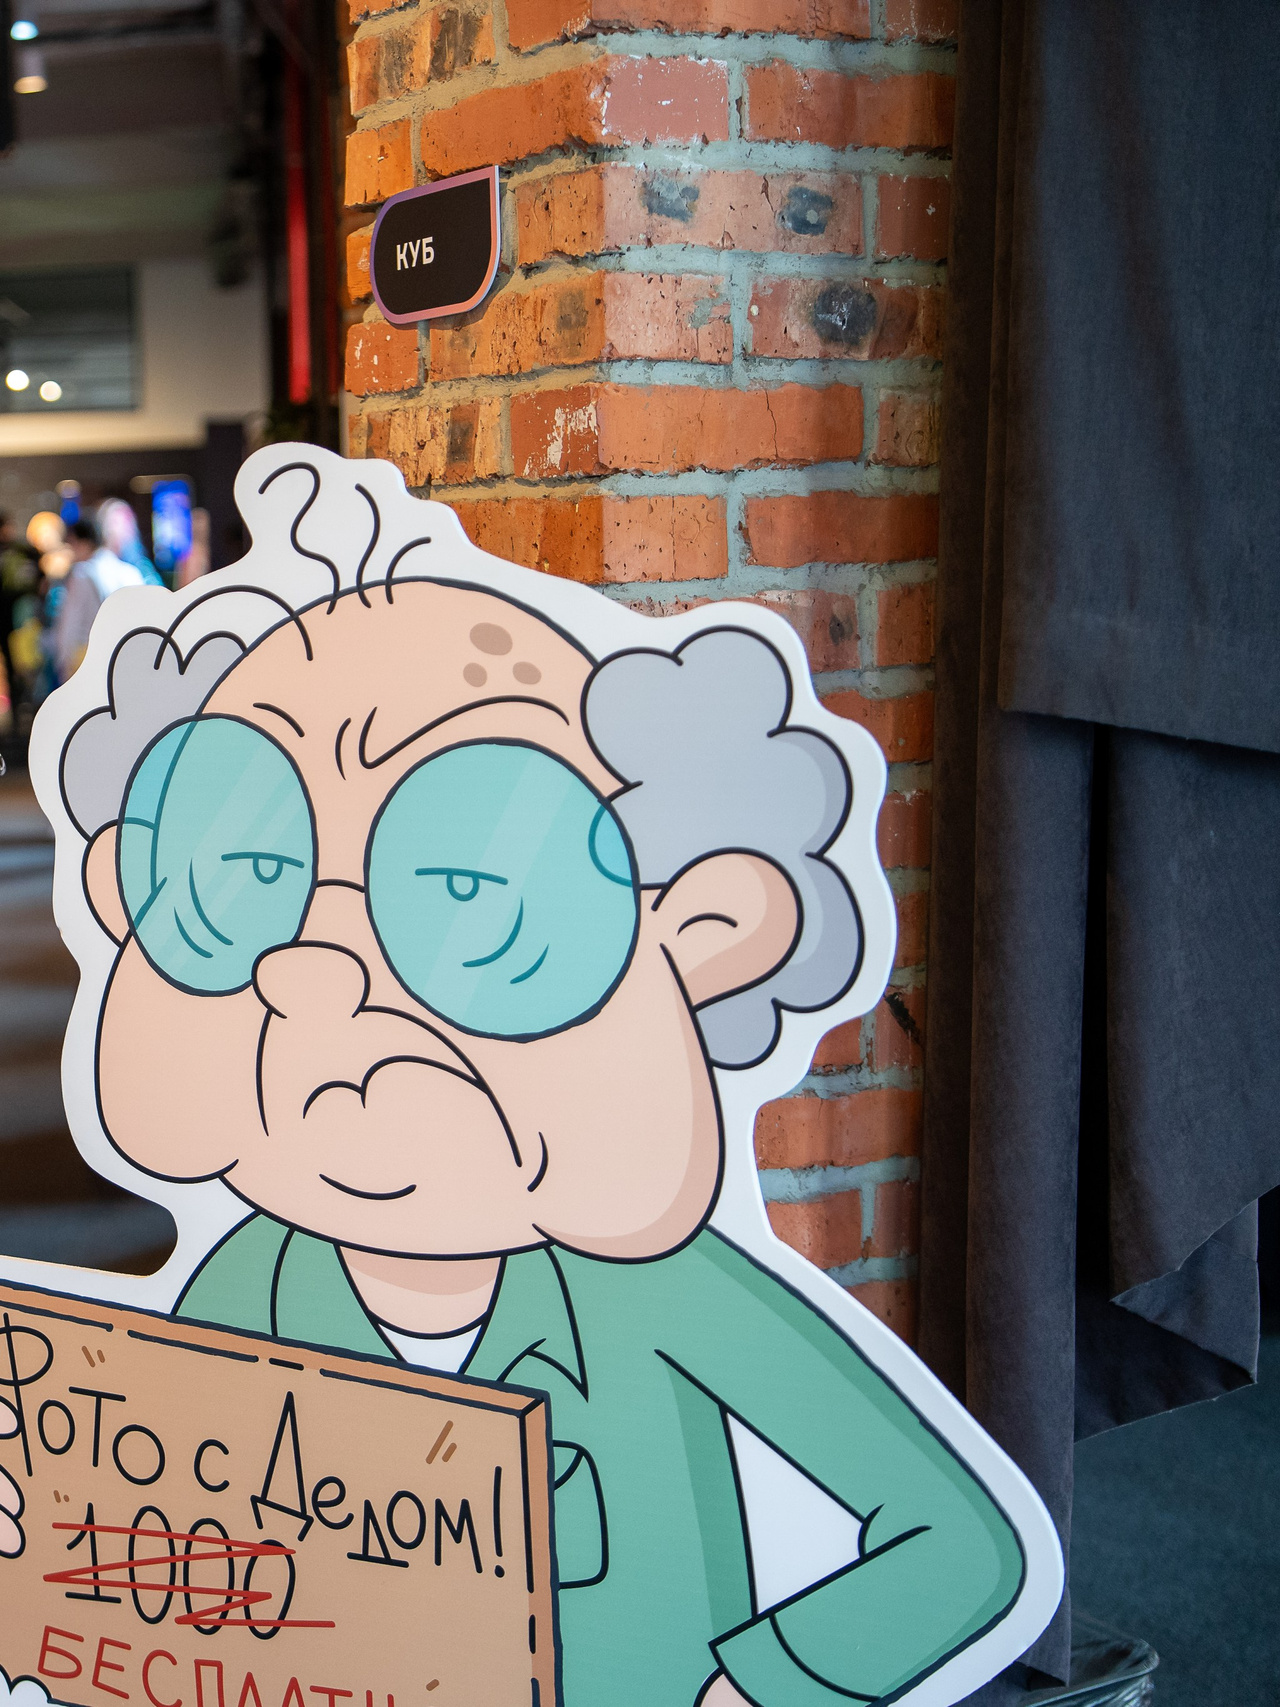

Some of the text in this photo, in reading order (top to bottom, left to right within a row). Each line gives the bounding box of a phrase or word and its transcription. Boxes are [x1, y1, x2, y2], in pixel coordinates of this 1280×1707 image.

[396, 236, 435, 271] КУБ
[193, 1437, 231, 1493] с
[249, 1390, 507, 1578] Дедом!
[65, 1502, 297, 1640] 1000
